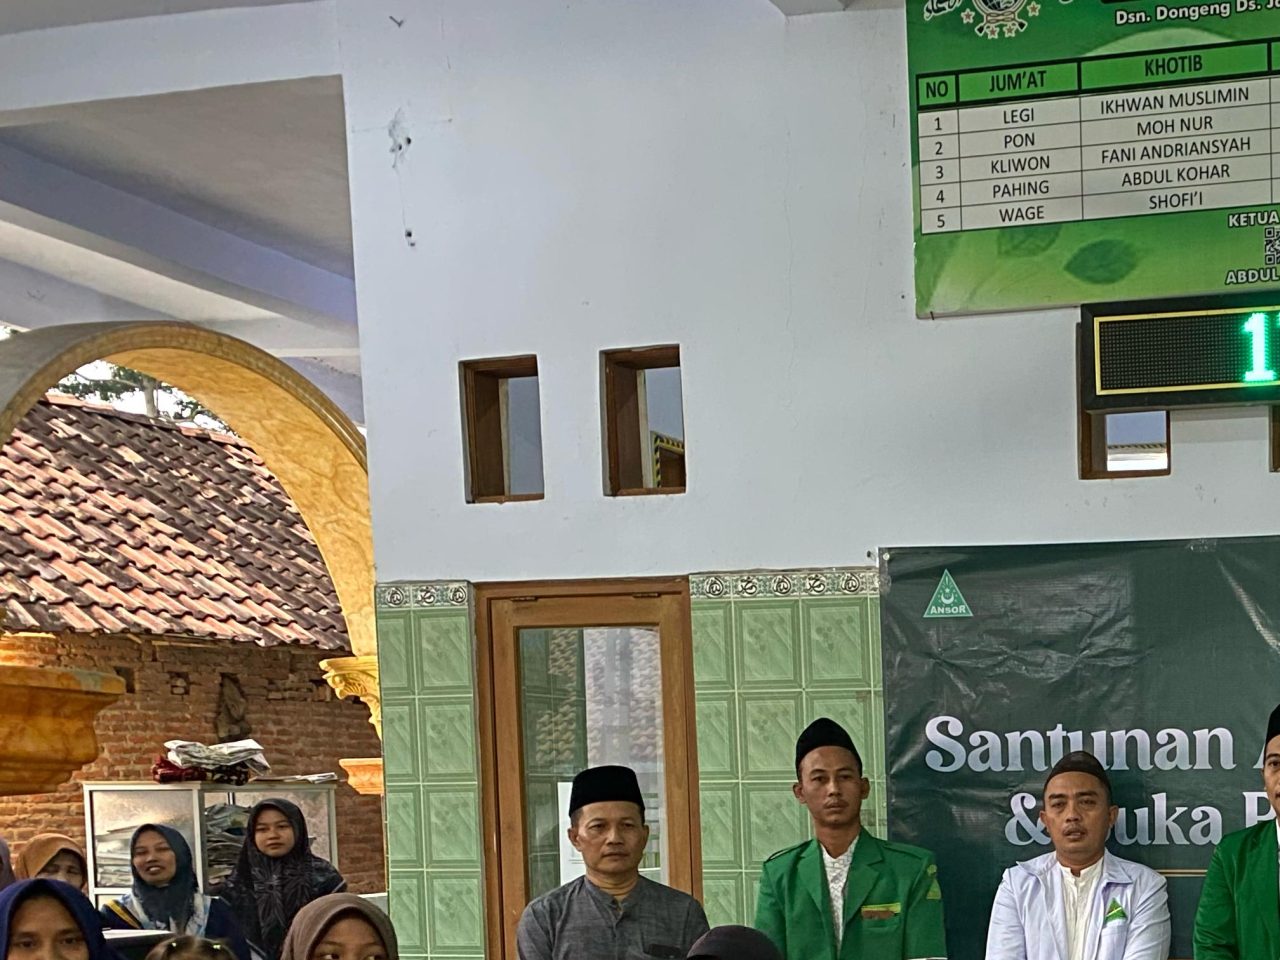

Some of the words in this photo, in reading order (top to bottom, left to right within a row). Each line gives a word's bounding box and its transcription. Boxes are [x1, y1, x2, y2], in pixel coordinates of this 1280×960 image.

[1116, 10, 1151, 25] Dsn.
[1157, 3, 1231, 21] Dongeng
[1144, 55, 1203, 76] KHOTIB
[926, 81, 949, 98] NO
[1100, 92, 1164, 115] IKHWAN
[1169, 87, 1249, 109] MUSLIMIN
[934, 117, 943, 131] 1
[1003, 109, 1035, 124] LEGI
[1137, 120, 1175, 136] MOH
[1180, 116, 1213, 132] NUR
[934, 141, 944, 155] 2
[1004, 132, 1035, 149] PON
[1101, 149, 1136, 165] FANI
[1140, 137, 1251, 161] ANDRIANSYAH
[935, 165, 944, 179] 3
[990, 155, 1050, 174] KLIWON
[1121, 169, 1173, 187] ABDUL
[1177, 164, 1230, 182] KOHAR
[936, 190, 945, 203] 4
[992, 180, 1049, 198] PAHING
[937, 214, 945, 228] 5
[999, 205, 1045, 223] WAGE
[1228, 211, 1280, 228] KETUA
[1225, 267, 1280, 285] ABDUL
[930, 604, 966, 614] ANSOR
[925, 714, 1237, 773] Santunan
[1004, 792, 1053, 846] &
[1107, 792, 1222, 846] uka
